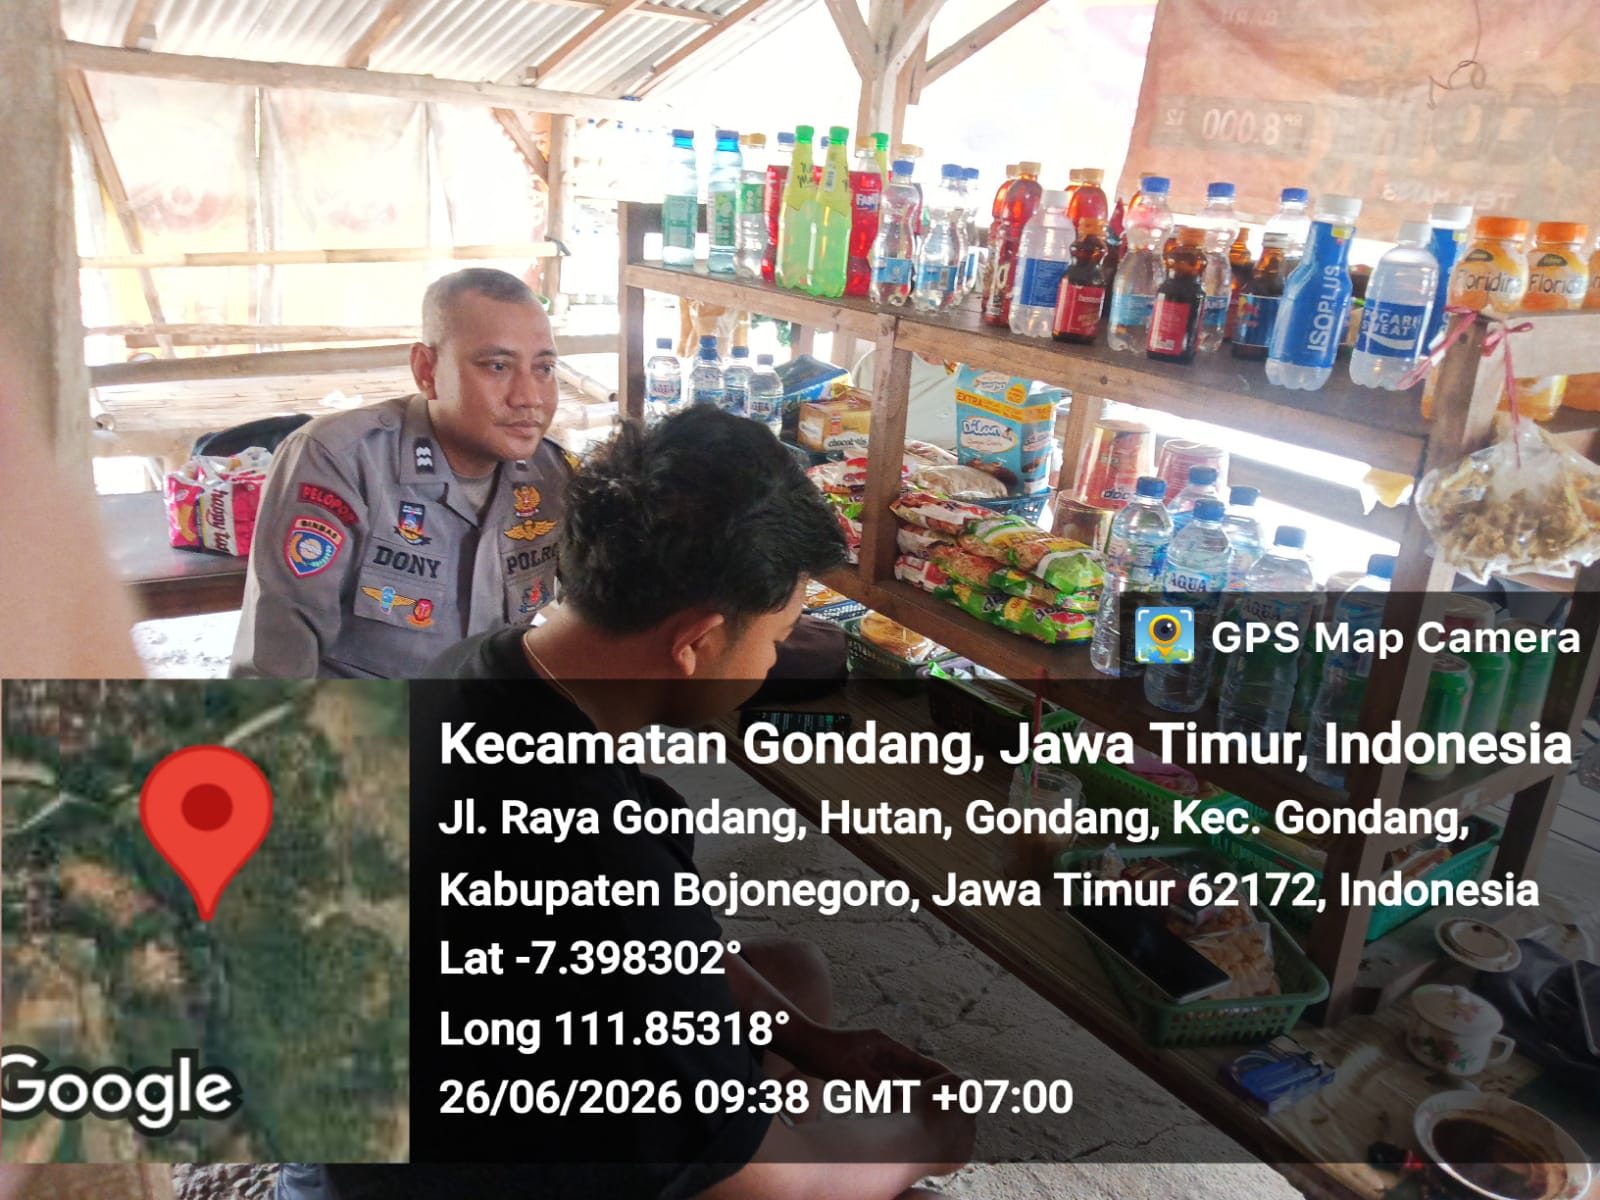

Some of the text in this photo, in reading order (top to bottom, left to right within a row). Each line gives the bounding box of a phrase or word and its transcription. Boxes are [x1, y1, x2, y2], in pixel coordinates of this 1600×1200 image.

[1306, 264, 1341, 358] ISOPLUS
[956, 390, 982, 407] EXTRA
[206, 488, 229, 531] happy
[373, 544, 441, 579] DONY
[1169, 573, 1207, 593] AQUA
